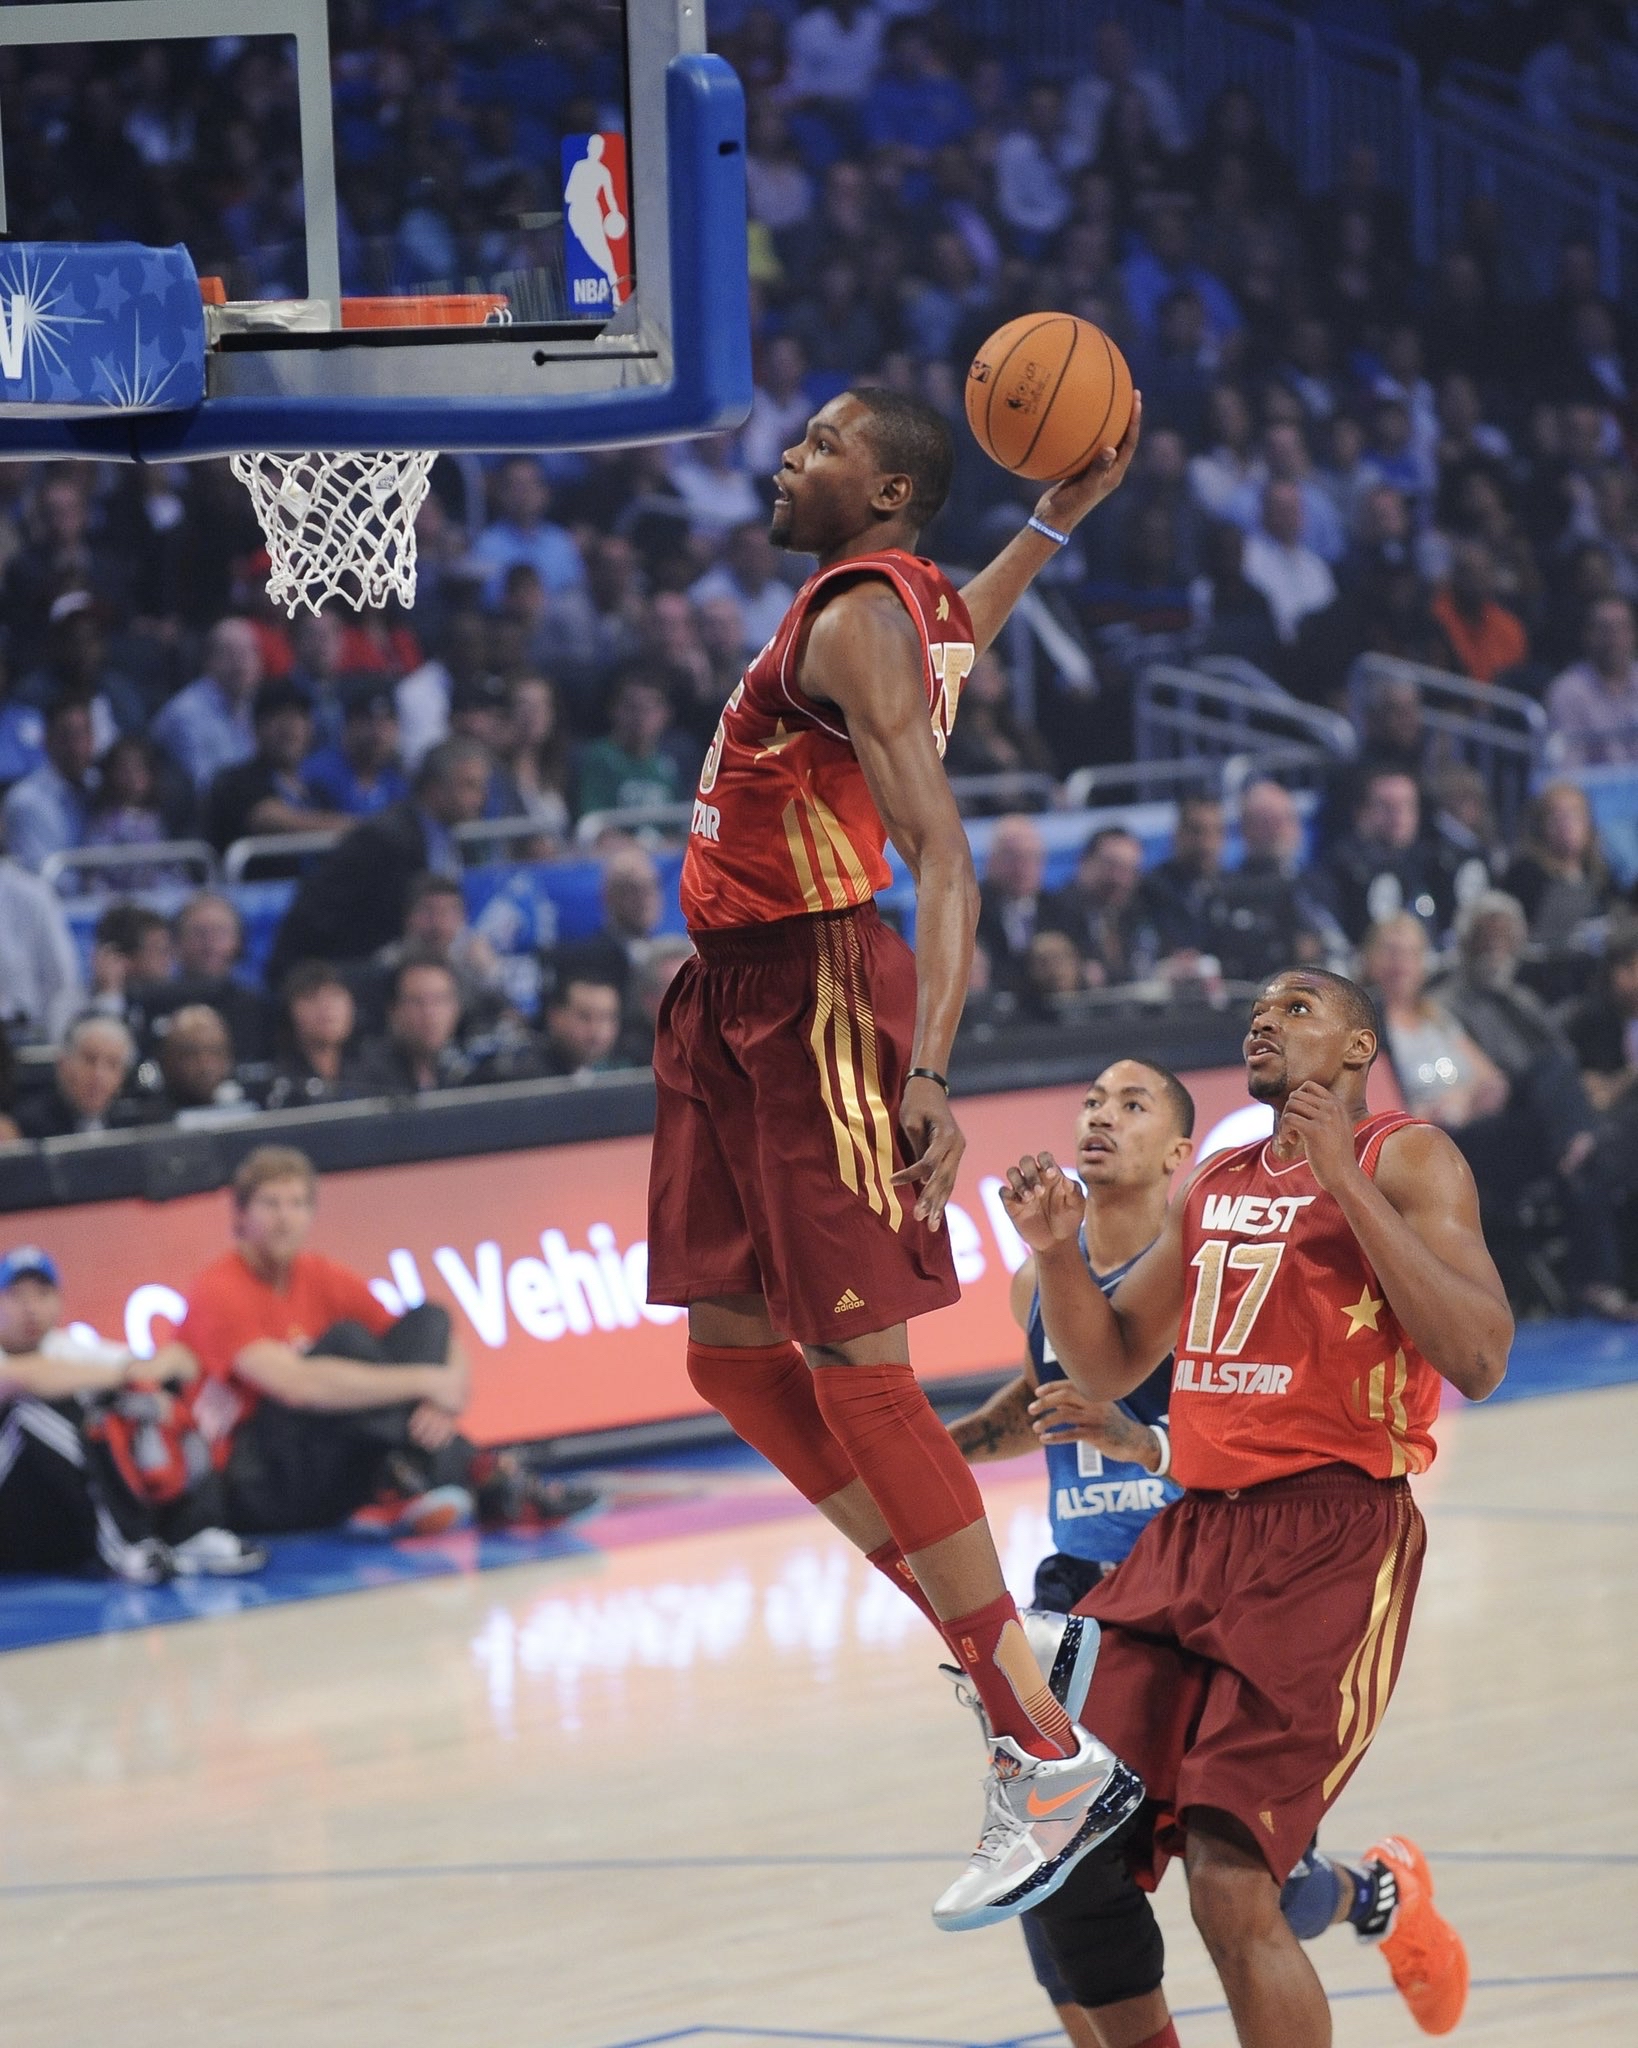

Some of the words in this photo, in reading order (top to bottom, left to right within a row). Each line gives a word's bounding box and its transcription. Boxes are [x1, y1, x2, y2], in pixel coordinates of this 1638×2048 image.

[573, 277, 609, 305] NBA
[1201, 1194, 1317, 1236] WEST
[834, 1299, 865, 1314] adidas
[1189, 1239, 1286, 1356] 17
